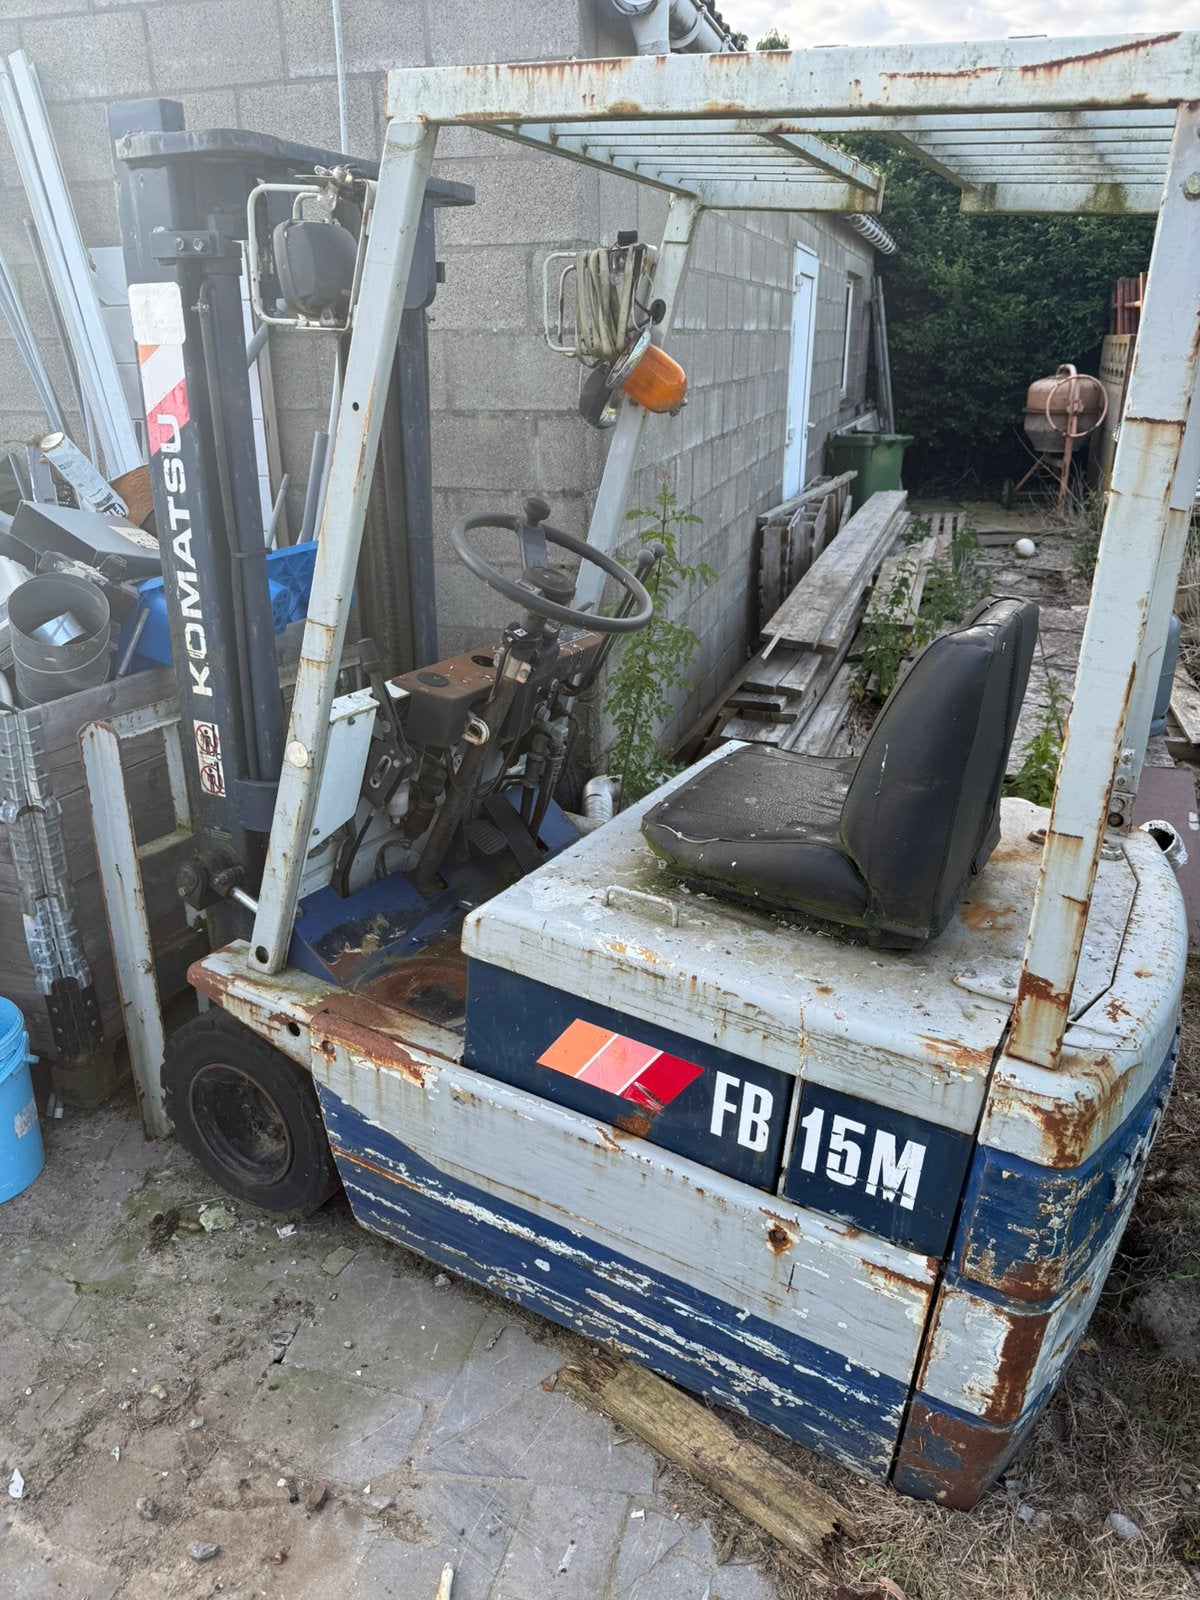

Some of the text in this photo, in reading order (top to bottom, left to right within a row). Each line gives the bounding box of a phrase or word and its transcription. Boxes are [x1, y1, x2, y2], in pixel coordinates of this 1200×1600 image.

[157, 414, 213, 697] KOMATSU
[710, 1070, 927, 1211] FB 15M
